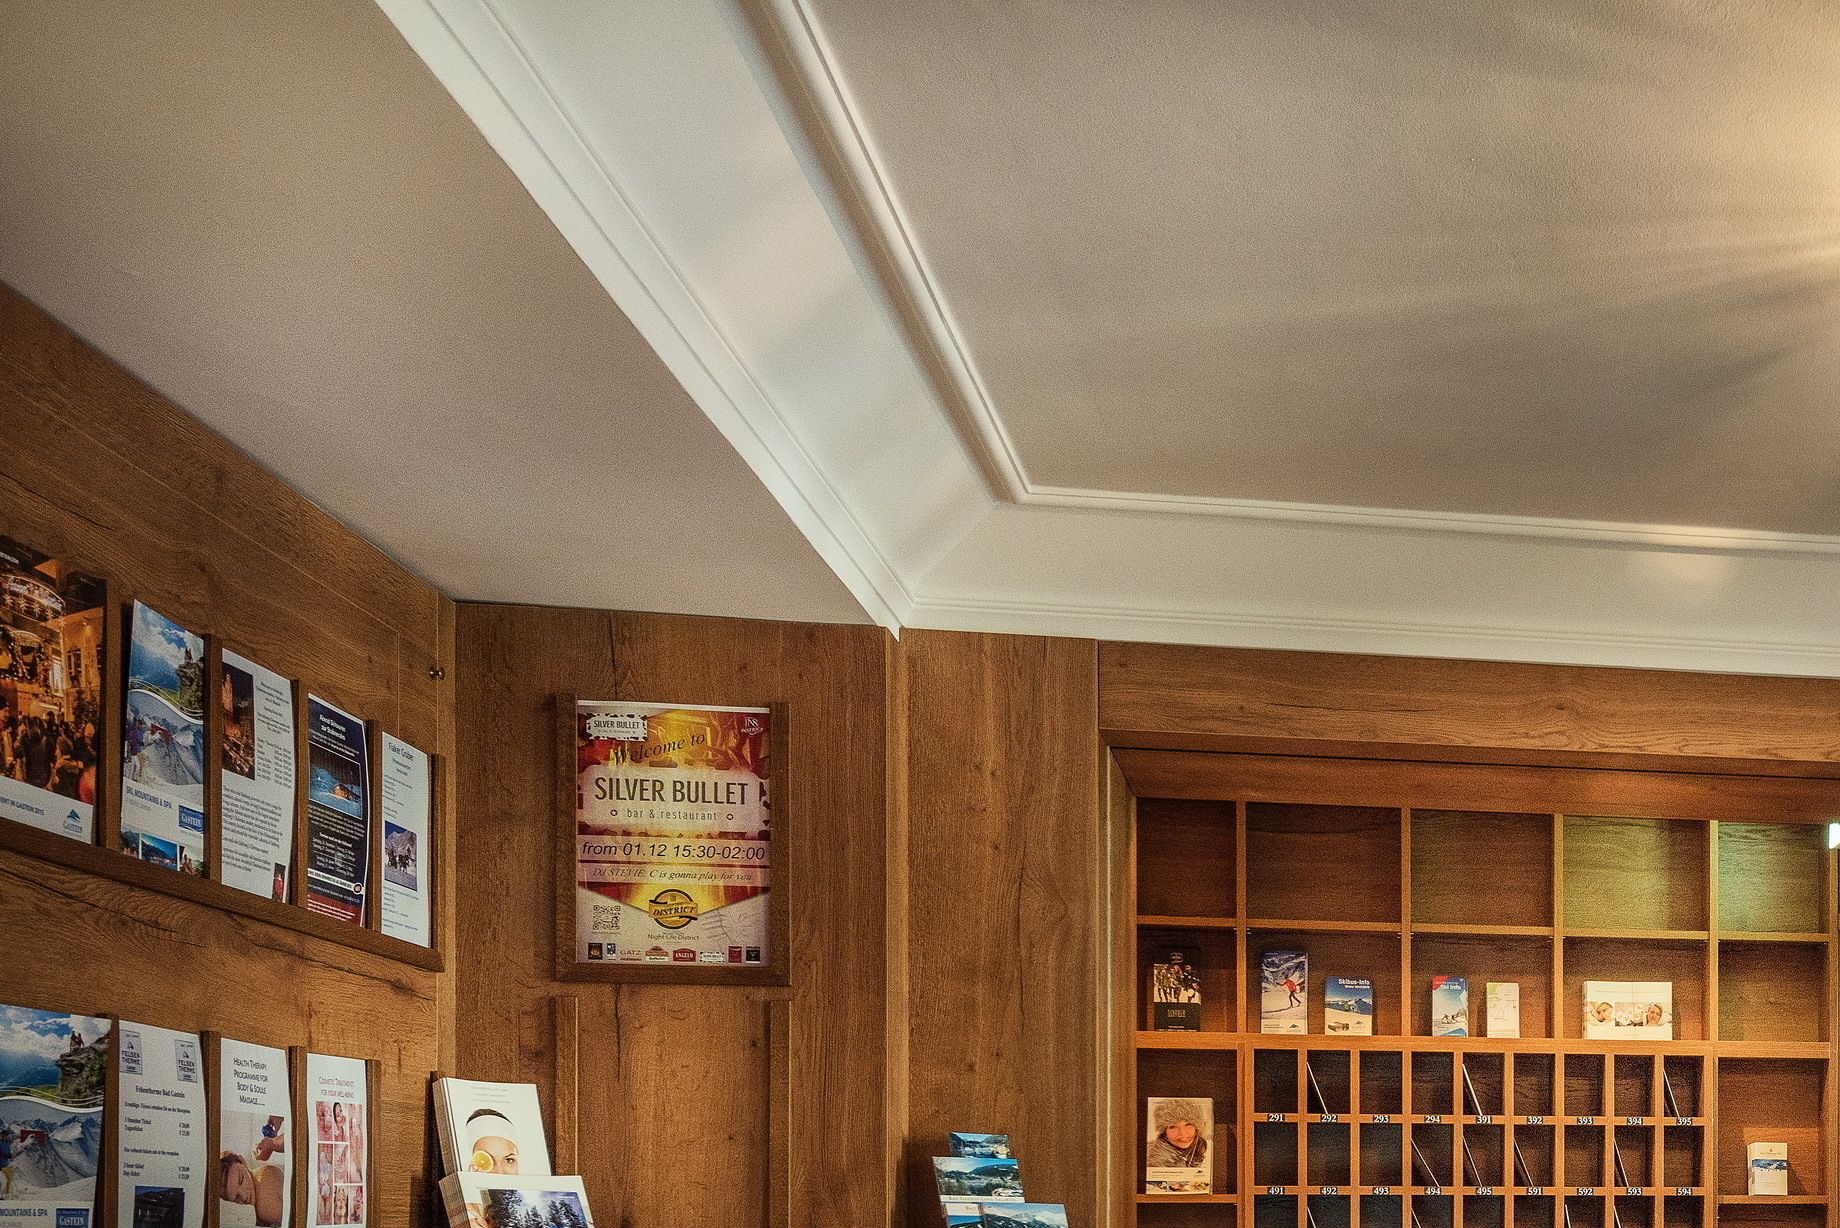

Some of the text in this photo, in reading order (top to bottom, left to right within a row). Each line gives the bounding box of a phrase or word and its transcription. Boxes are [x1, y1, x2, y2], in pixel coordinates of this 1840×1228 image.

[593, 719, 640, 730] SILVER BULLET
[612, 733, 706, 766] Welcome to
[594, 776, 749, 806] SILVER BULLET
[626, 808, 718, 821] bar & restaurant
[582, 841, 766, 860] from 01.12 15:30-02:00
[649, 868, 659, 878] C
[659, 870, 668, 879] is
[668, 871, 698, 881] gonna
[698, 870, 718, 882] play
[717, 870, 734, 883] for
[735, 873, 752, 883] you
[652, 905, 696, 916] DISTRICT
[647, 933, 665, 941] Night
[665, 933, 677, 941] Life
[677, 933, 700, 941] District
[1338, 978, 1371, 986] Skibus-Info
[121, 1050, 140, 1059] FELSEN
[121, 1056, 141, 1066] THERME
[178, 1059, 195, 1068] FELSEN
[178, 1065, 196, 1074] THERME
[237, 1081, 250, 1092] BODY
[162, 1089, 171, 1097] Bad
[1268, 1113, 1284, 1122] 291
[1320, 1113, 1337, 1123] 292
[1373, 1114, 1390, 1123] 293
[1424, 1114, 1441, 1124] 294
[1476, 1115, 1492, 1124] 391
[1526, 1115, 1543, 1124] 392
[1577, 1116, 1593, 1125] 393
[1627, 1116, 1643, 1126] 394
[1677, 1117, 1693, 1126] 395
[1269, 1186, 1285, 1195] 491
[1321, 1186, 1337, 1195] 492
[1373, 1186, 1390, 1196] 493
[1425, 1187, 1442, 1196] 494
[1476, 1187, 1492, 1196] 495
[1527, 1187, 1543, 1196] 591
[1578, 1187, 1593, 1196] 592
[1627, 1187, 1643, 1197] 593
[1677, 1187, 1693, 1196] 594
[37, 1208, 48, 1217] SPA
[59, 1215, 85, 1227] GASTEIN
